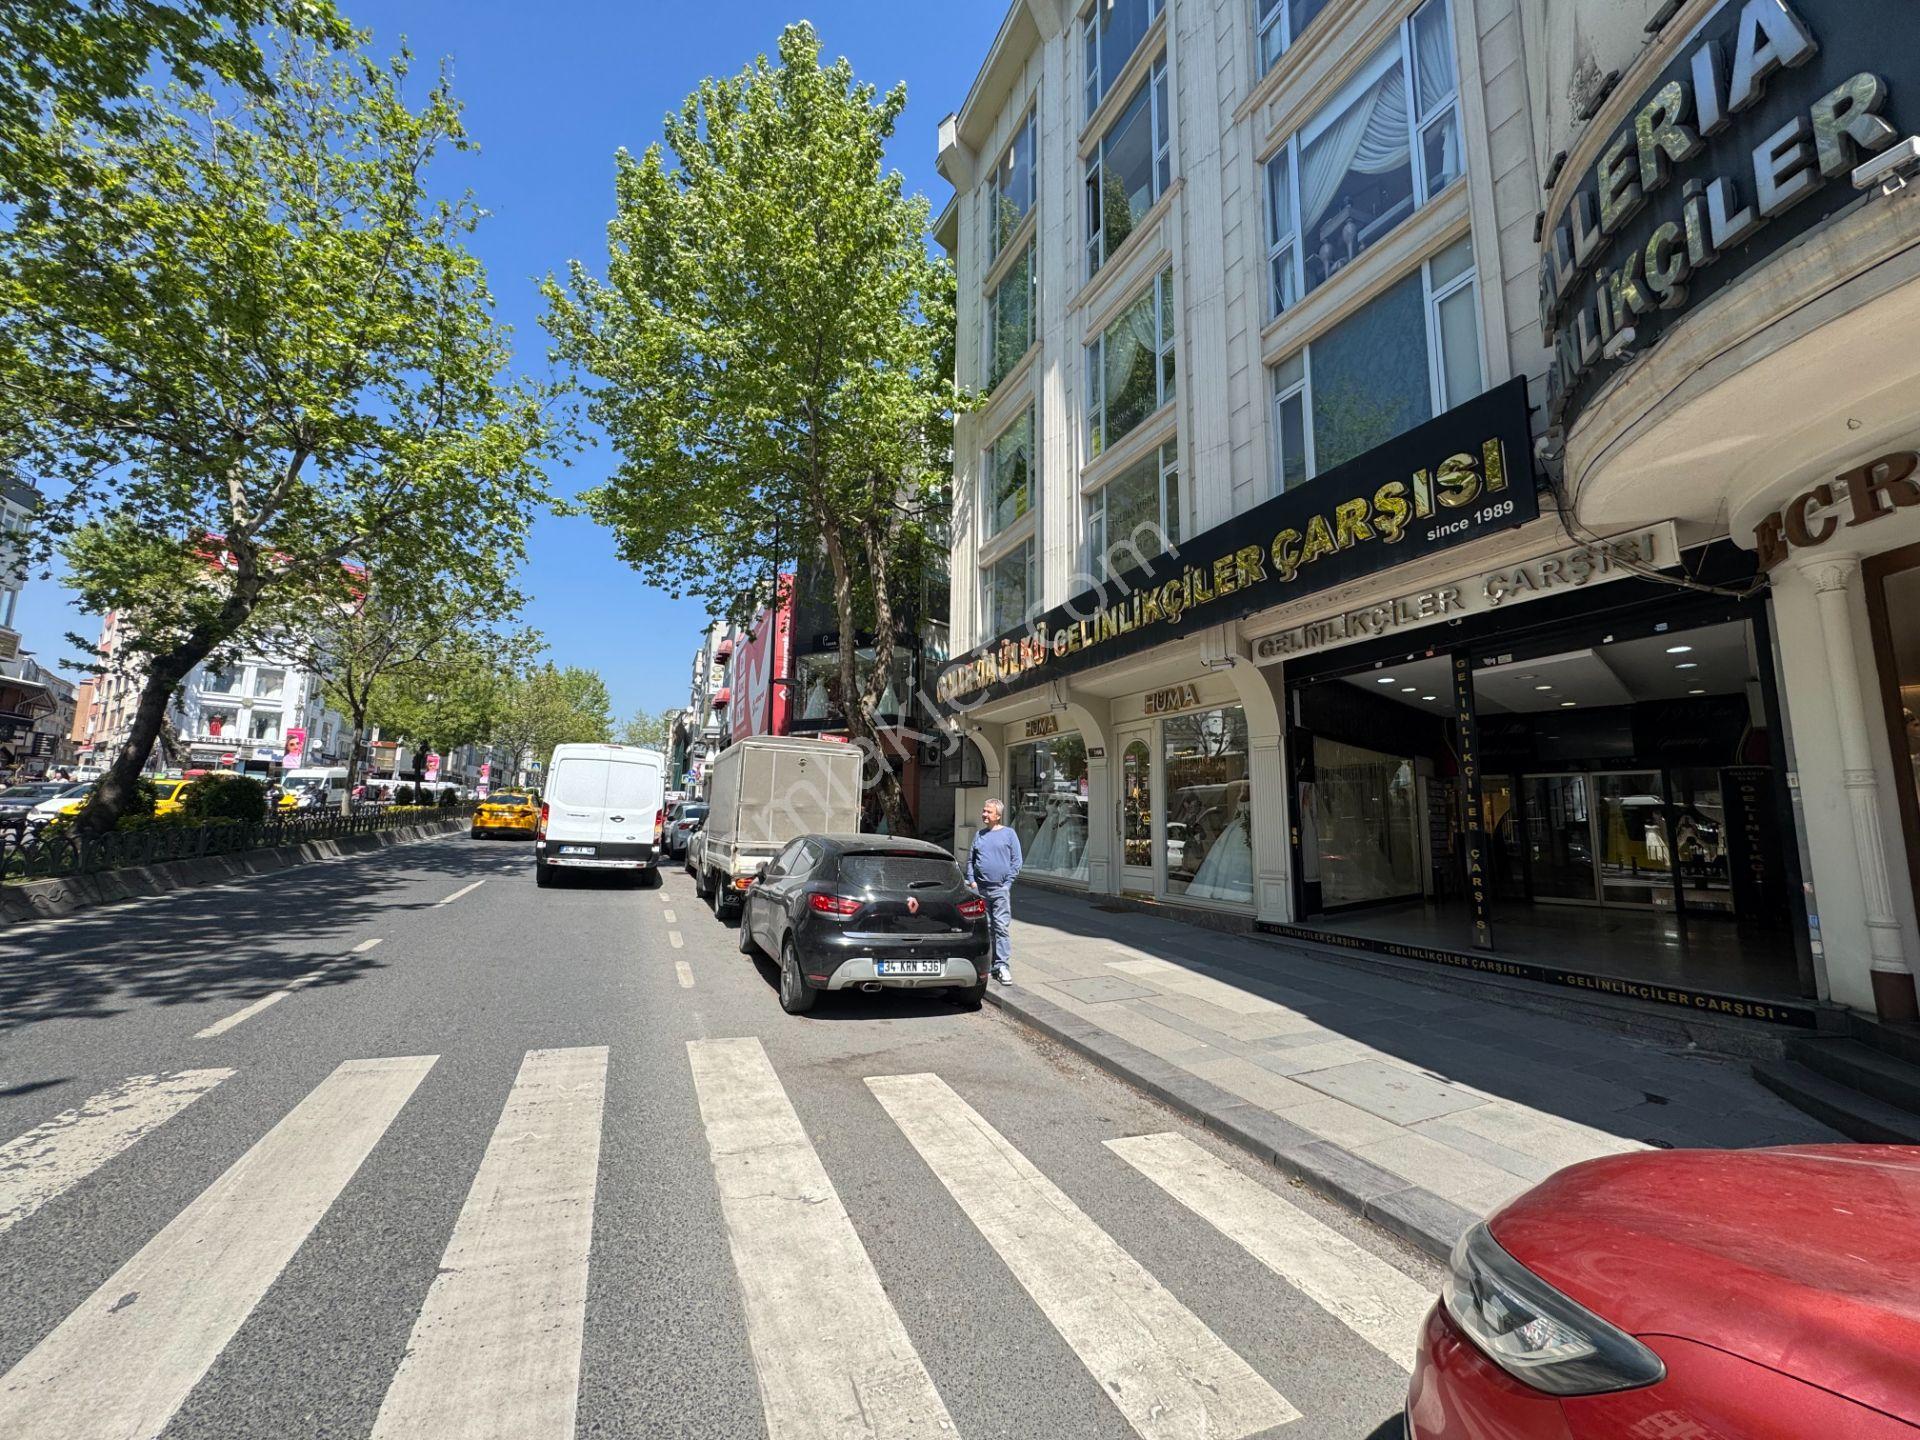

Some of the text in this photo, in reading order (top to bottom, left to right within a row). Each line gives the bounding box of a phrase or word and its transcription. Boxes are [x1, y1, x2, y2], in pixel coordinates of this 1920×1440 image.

[1270, 435, 1510, 582] ÇARŞISI
[1425, 499, 1515, 542] since 1989
[1482, 532, 1656, 605] ÇARŞISI
[884, 960, 939, 972] 34 KRN 536
